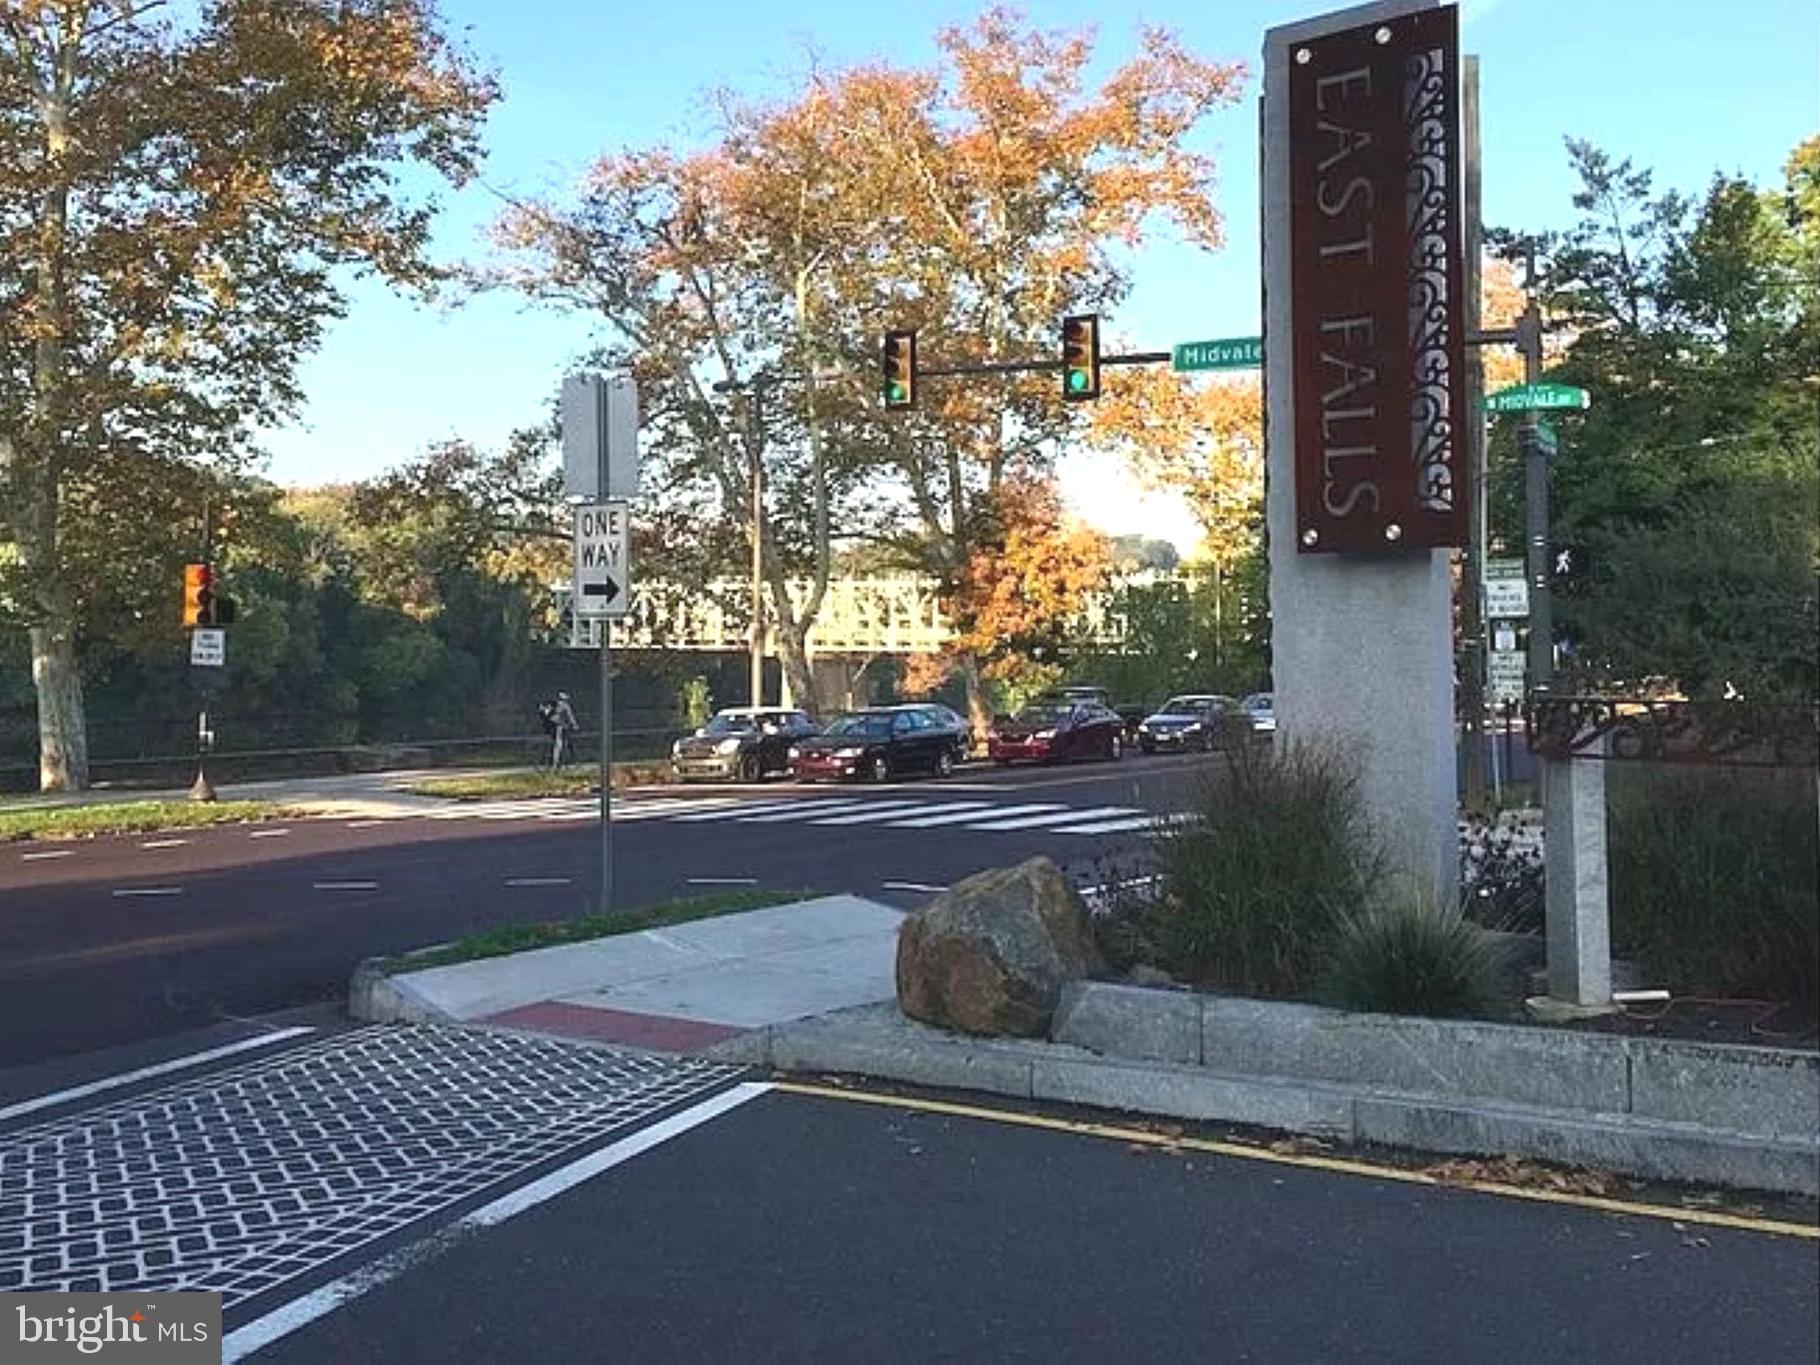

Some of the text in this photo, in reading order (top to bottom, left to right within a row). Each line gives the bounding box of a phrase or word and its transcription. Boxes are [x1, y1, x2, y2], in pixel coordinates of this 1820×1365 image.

[1316, 65, 1380, 516] EAST FALLS
[583, 511, 619, 538] ONE
[583, 543, 620, 568] WAY
